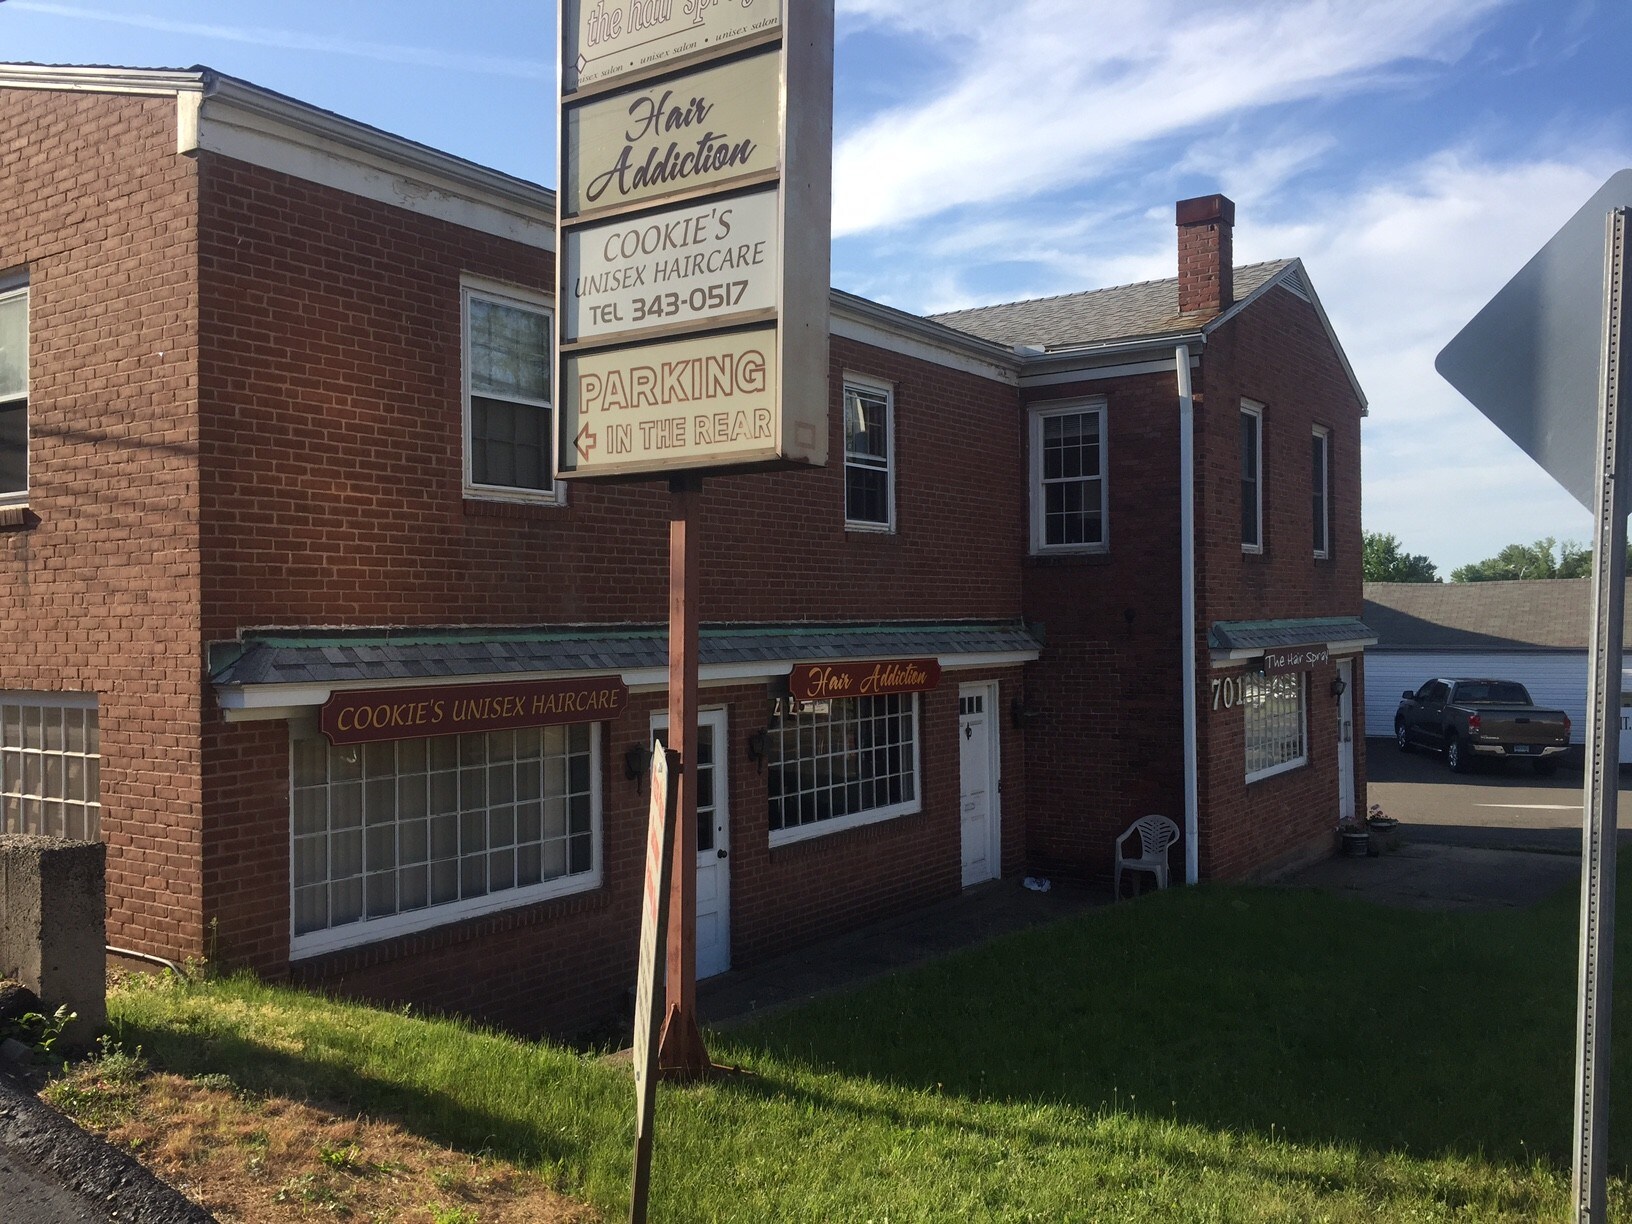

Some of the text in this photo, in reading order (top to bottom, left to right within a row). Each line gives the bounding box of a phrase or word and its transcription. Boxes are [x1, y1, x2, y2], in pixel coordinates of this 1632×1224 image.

[587, 2, 622, 47] the
[601, 65, 623, 77] salon
[640, 50, 670, 65] unisex
[672, 41, 697, 55] salon
[715, 24, 748, 41] unisex
[750, 15, 778, 30] salon
[625, 90, 714, 142] Hair
[586, 131, 757, 202] Addiction
[603, 208, 733, 262] COOKIE'S
[574, 240, 766, 298] UNISEX HAIRCARE
[589, 279, 749, 326] TEL 343-0517
[579, 350, 766, 414] PARKING
[606, 408, 772, 454] IN THE REAR
[806, 663, 928, 697] Hair Addiction
[1265, 650, 1329, 669] The Hair Spray
[337, 689, 620, 731] COOKIE'S UNISEX HAIRCARE
[1211, 676, 1243, 711] 701
